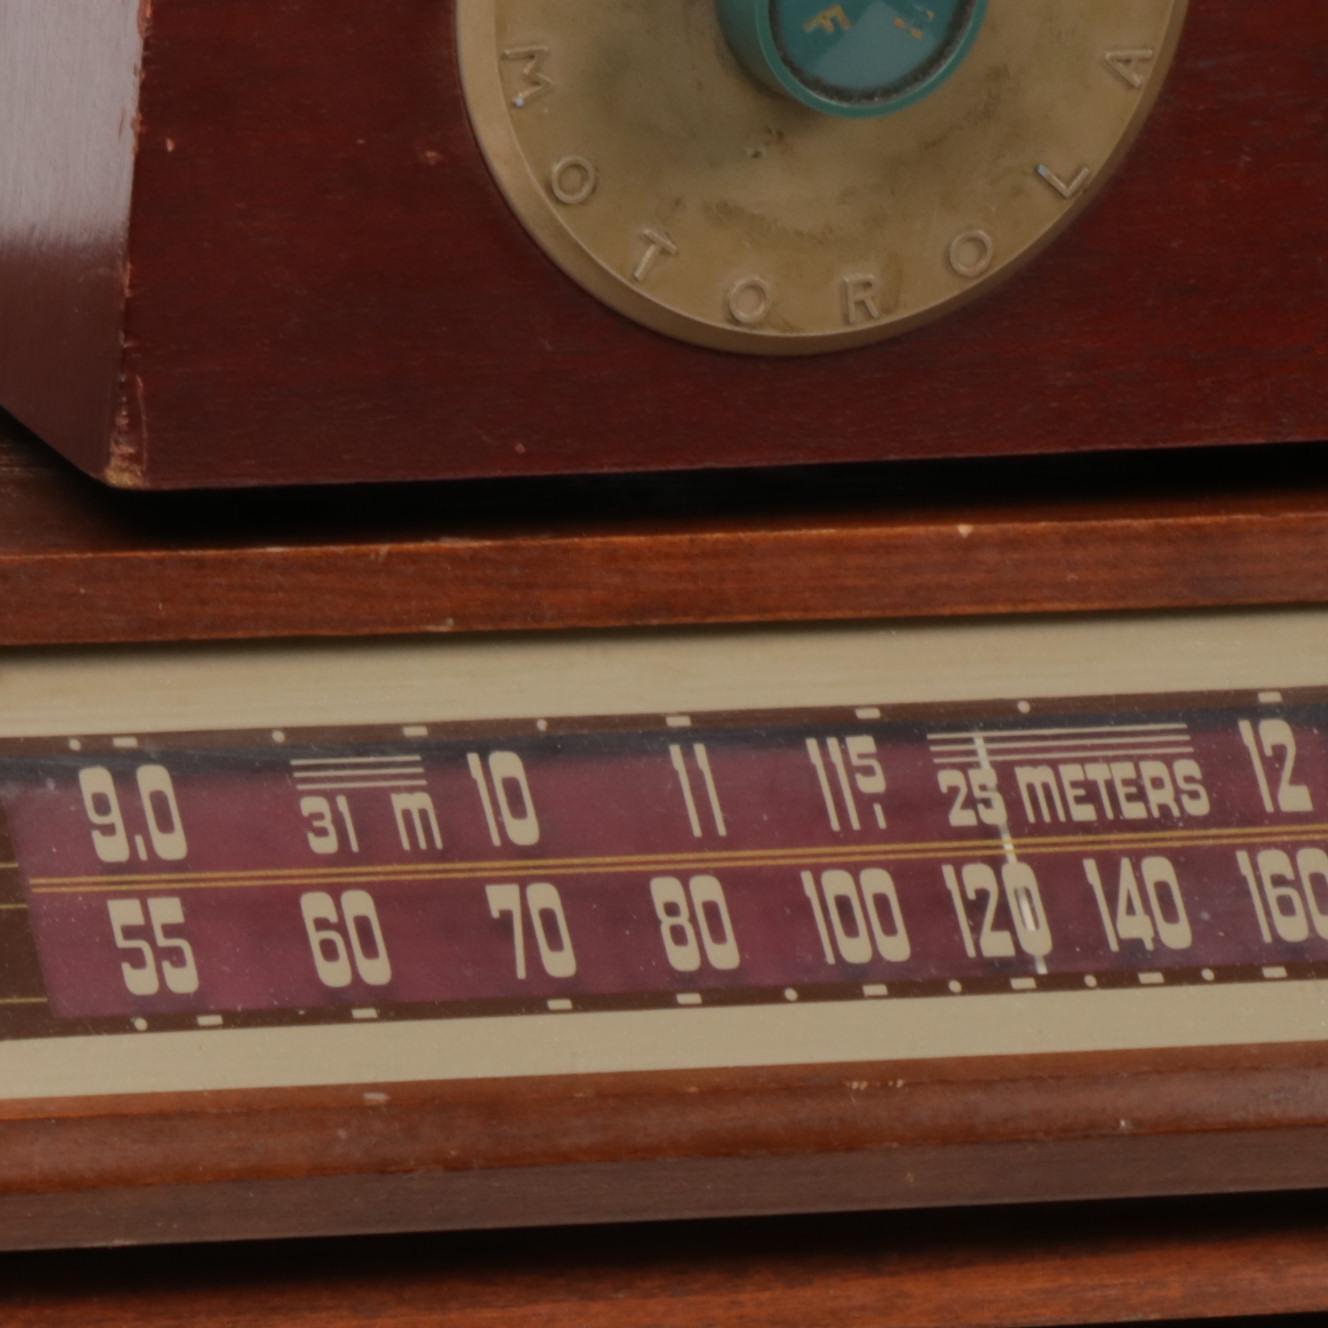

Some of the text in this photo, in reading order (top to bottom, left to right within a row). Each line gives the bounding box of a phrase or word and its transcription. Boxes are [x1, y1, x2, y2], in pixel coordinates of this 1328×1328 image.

[503, 43, 1153, 327] MOTOROLA
[78, 764, 188, 863] 9.0
[299, 795, 360, 855] 31
[466, 750, 541, 847] 10
[668, 743, 728, 838] 11
[936, 767, 1010, 828] 25
[1014, 758, 1211, 825] METERS
[1237, 718, 1314, 813] 12
[106, 847, 1328, 996] 55 60 70 80 100 120 140 160
